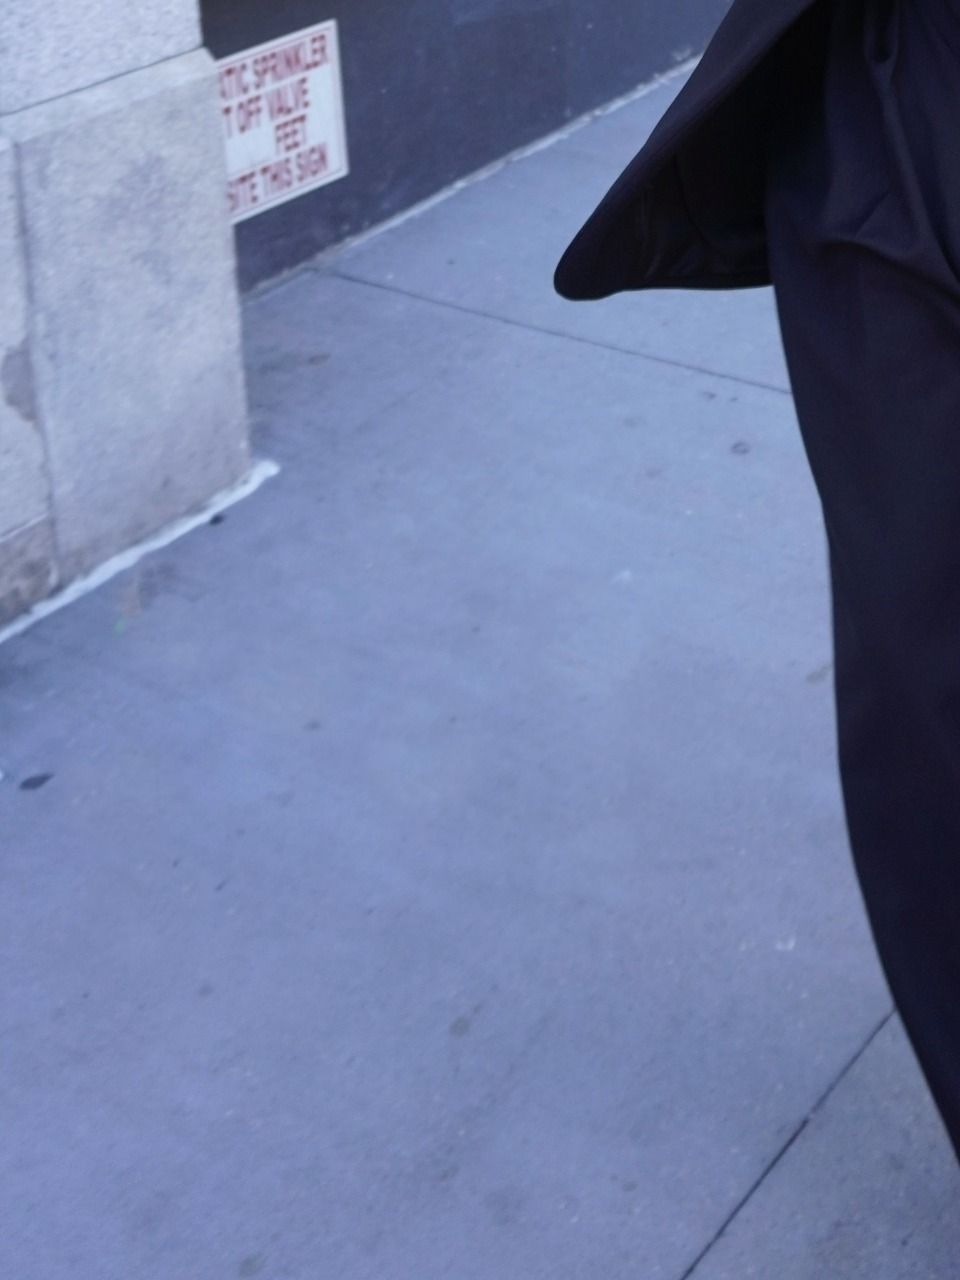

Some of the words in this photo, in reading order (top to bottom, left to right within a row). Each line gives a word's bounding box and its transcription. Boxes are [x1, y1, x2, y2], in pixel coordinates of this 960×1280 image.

[253, 33, 328, 89] SPRINKLER
[236, 94, 263, 134] OFF
[265, 76, 309, 122] VALVE
[274, 113, 307, 154] FEET
[260, 156, 291, 198] THIS
[294, 141, 328, 182] SIGN
